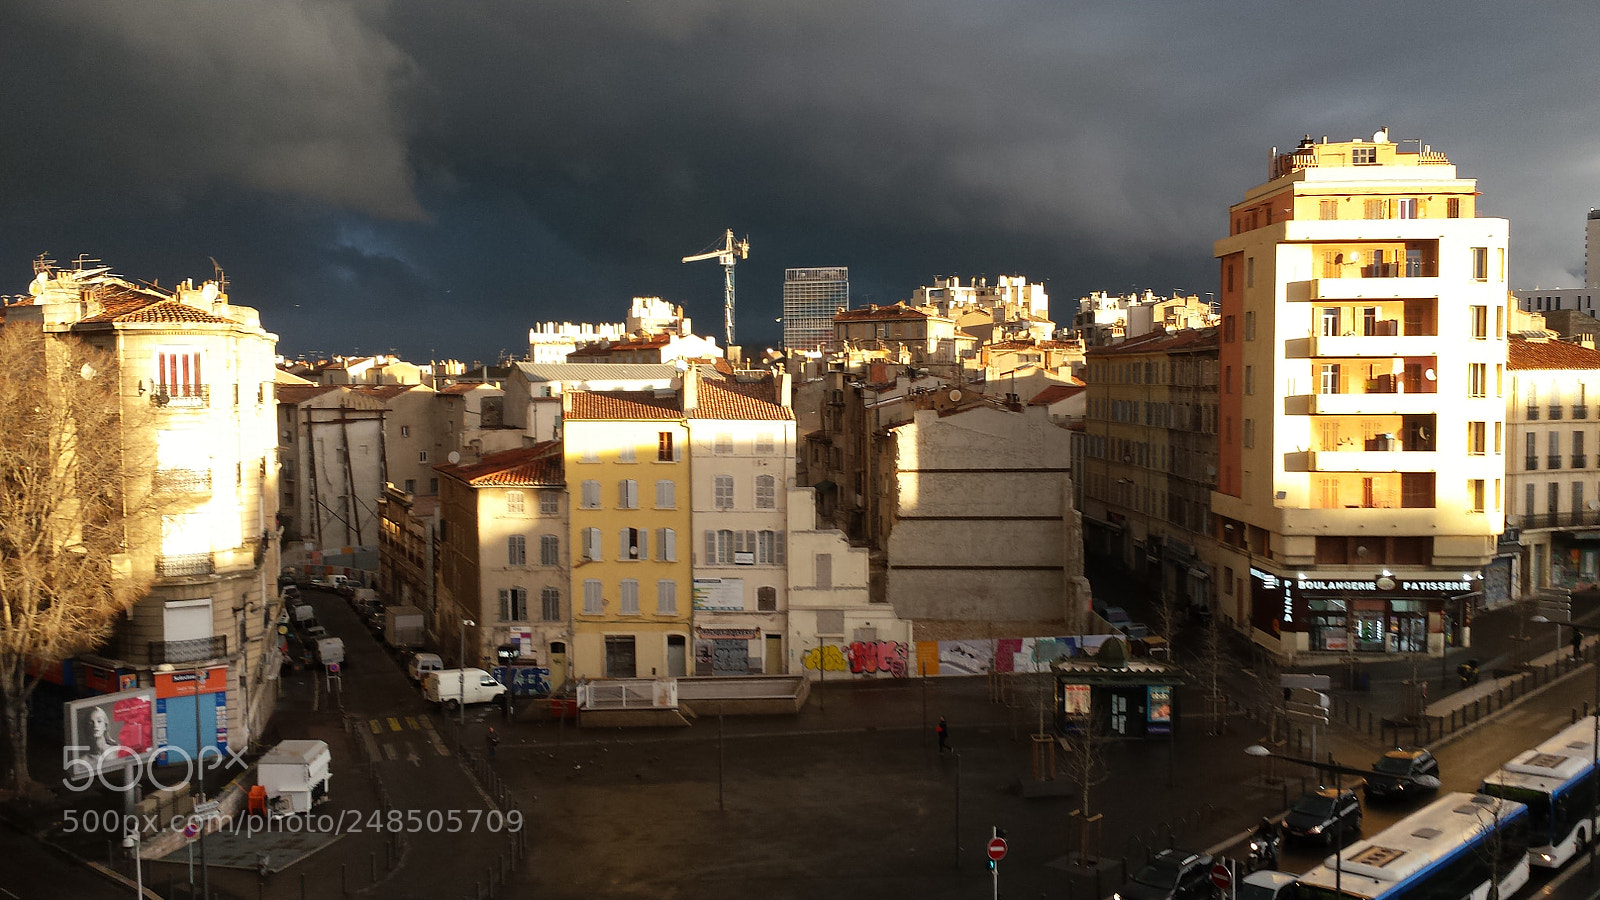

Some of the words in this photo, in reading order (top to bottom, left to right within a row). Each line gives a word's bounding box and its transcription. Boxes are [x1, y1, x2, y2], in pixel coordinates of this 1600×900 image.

[1298, 580, 1376, 591] BOULANGERIE
[1403, 580, 1472, 591] PATISSERIE
[1284, 579, 1293, 623] PIZZA
